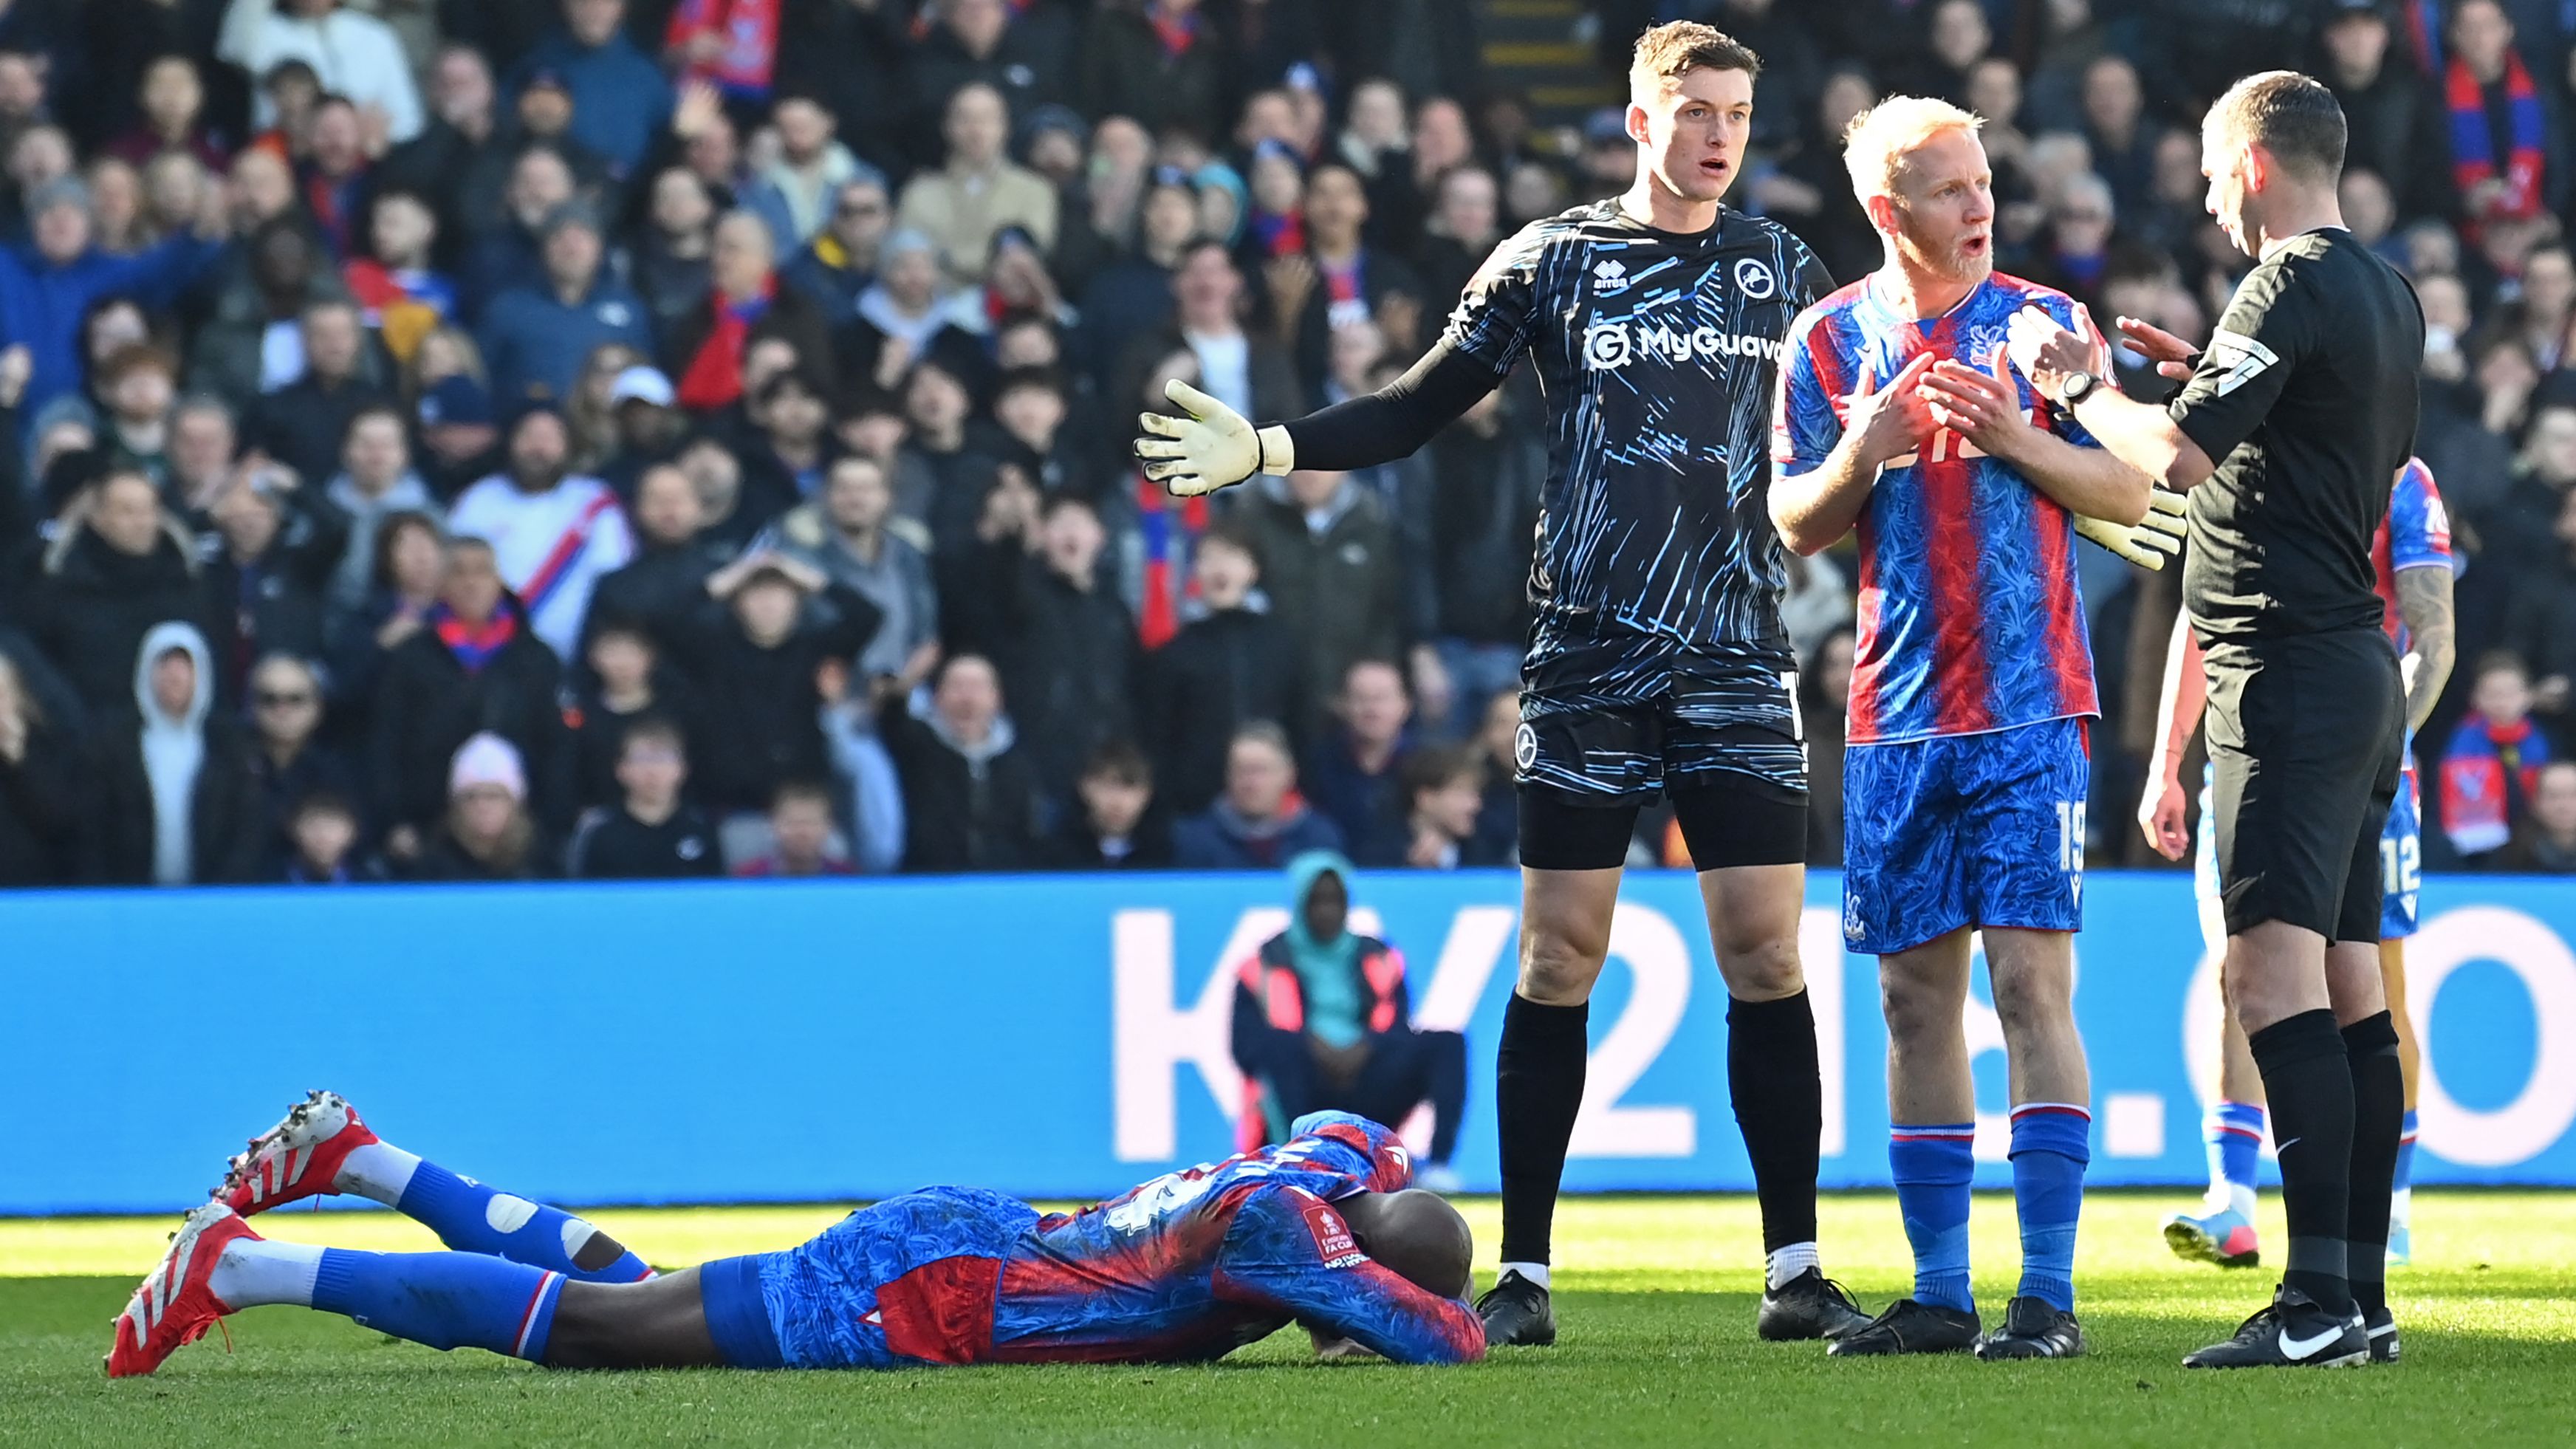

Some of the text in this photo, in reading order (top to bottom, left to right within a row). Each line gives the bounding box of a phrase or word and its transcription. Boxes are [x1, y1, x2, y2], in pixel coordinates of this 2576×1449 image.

[1639, 326, 1784, 364] MyGuava
[2056, 801, 2086, 872] 19
[2379, 835, 2421, 894] 12
[1111, 902, 2576, 1167] KY21.O
[1325, 1241, 1353, 1254] FA CUP
